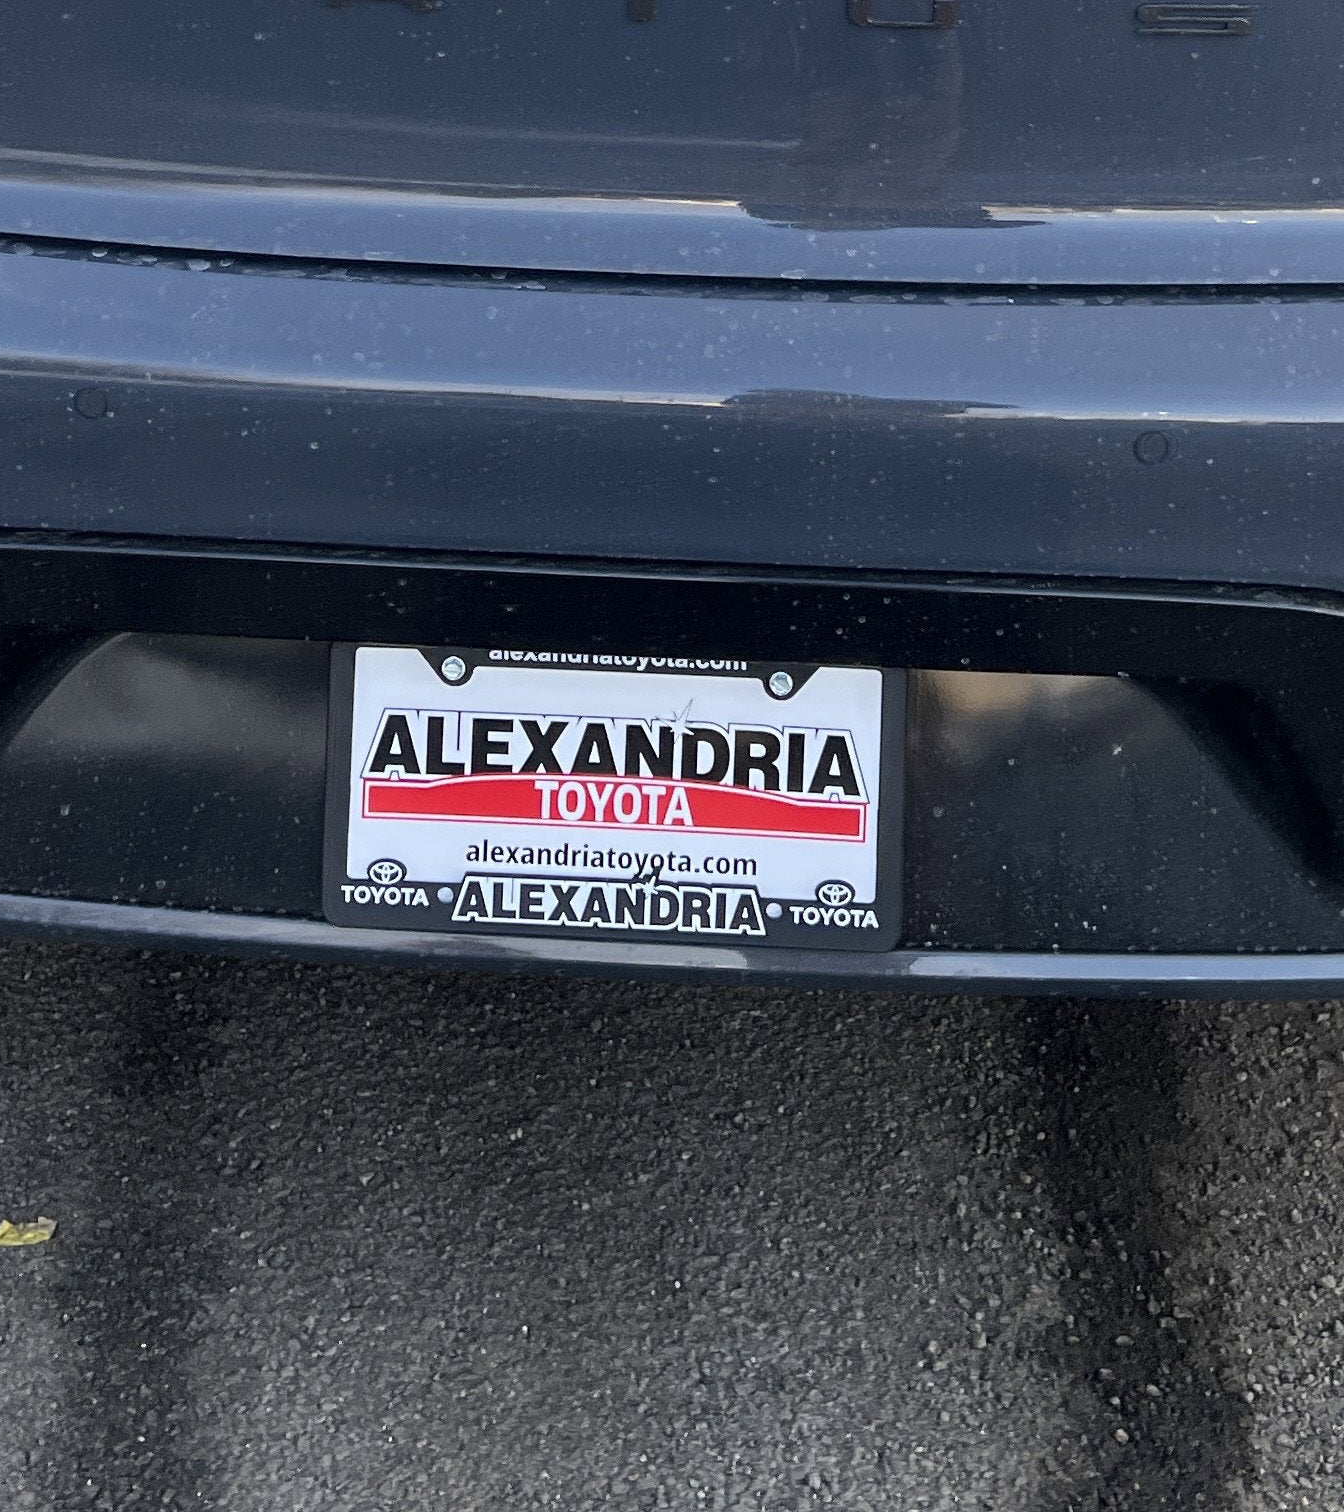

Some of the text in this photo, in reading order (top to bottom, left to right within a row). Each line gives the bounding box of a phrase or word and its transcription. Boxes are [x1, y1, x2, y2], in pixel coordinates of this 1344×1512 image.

[367, 711, 863, 798] ALEXANDRIA
[535, 781, 694, 827] TOYOTA
[465, 840, 758, 877] alexandriatoyota.com
[341, 884, 430, 908] TOYOTA
[455, 879, 764, 934] ALEXANDRIA
[789, 904, 880, 930] TOYOTA
